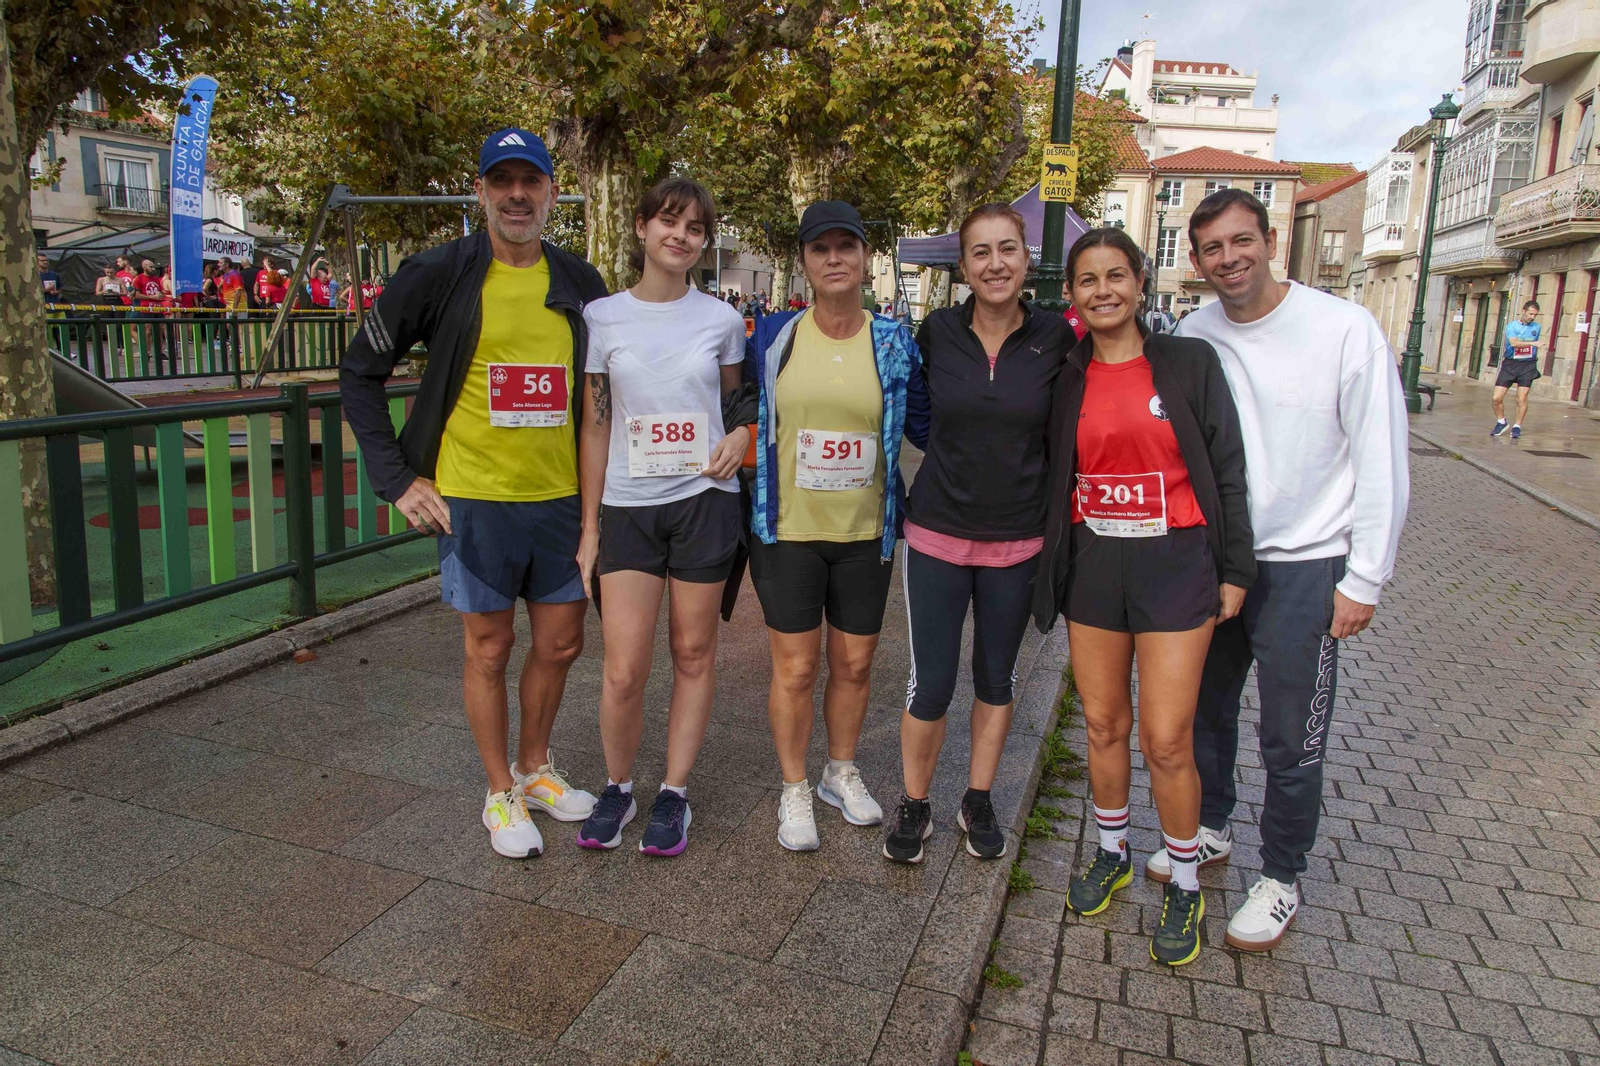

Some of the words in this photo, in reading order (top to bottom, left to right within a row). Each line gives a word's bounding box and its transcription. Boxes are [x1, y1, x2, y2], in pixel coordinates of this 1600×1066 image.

[191, 100, 210, 161] GALICIA
[176, 126, 191, 183] XUNTA
[1046, 148, 1076, 157] DESPACIO
[188, 167, 200, 188] DE
[1044, 186, 1072, 196] GATOS
[523, 373, 552, 395] 56
[651, 421, 696, 444] 588
[821, 439, 862, 460] 591
[1097, 483, 1145, 505] 201
[1299, 633, 1335, 767] LACOSTE
